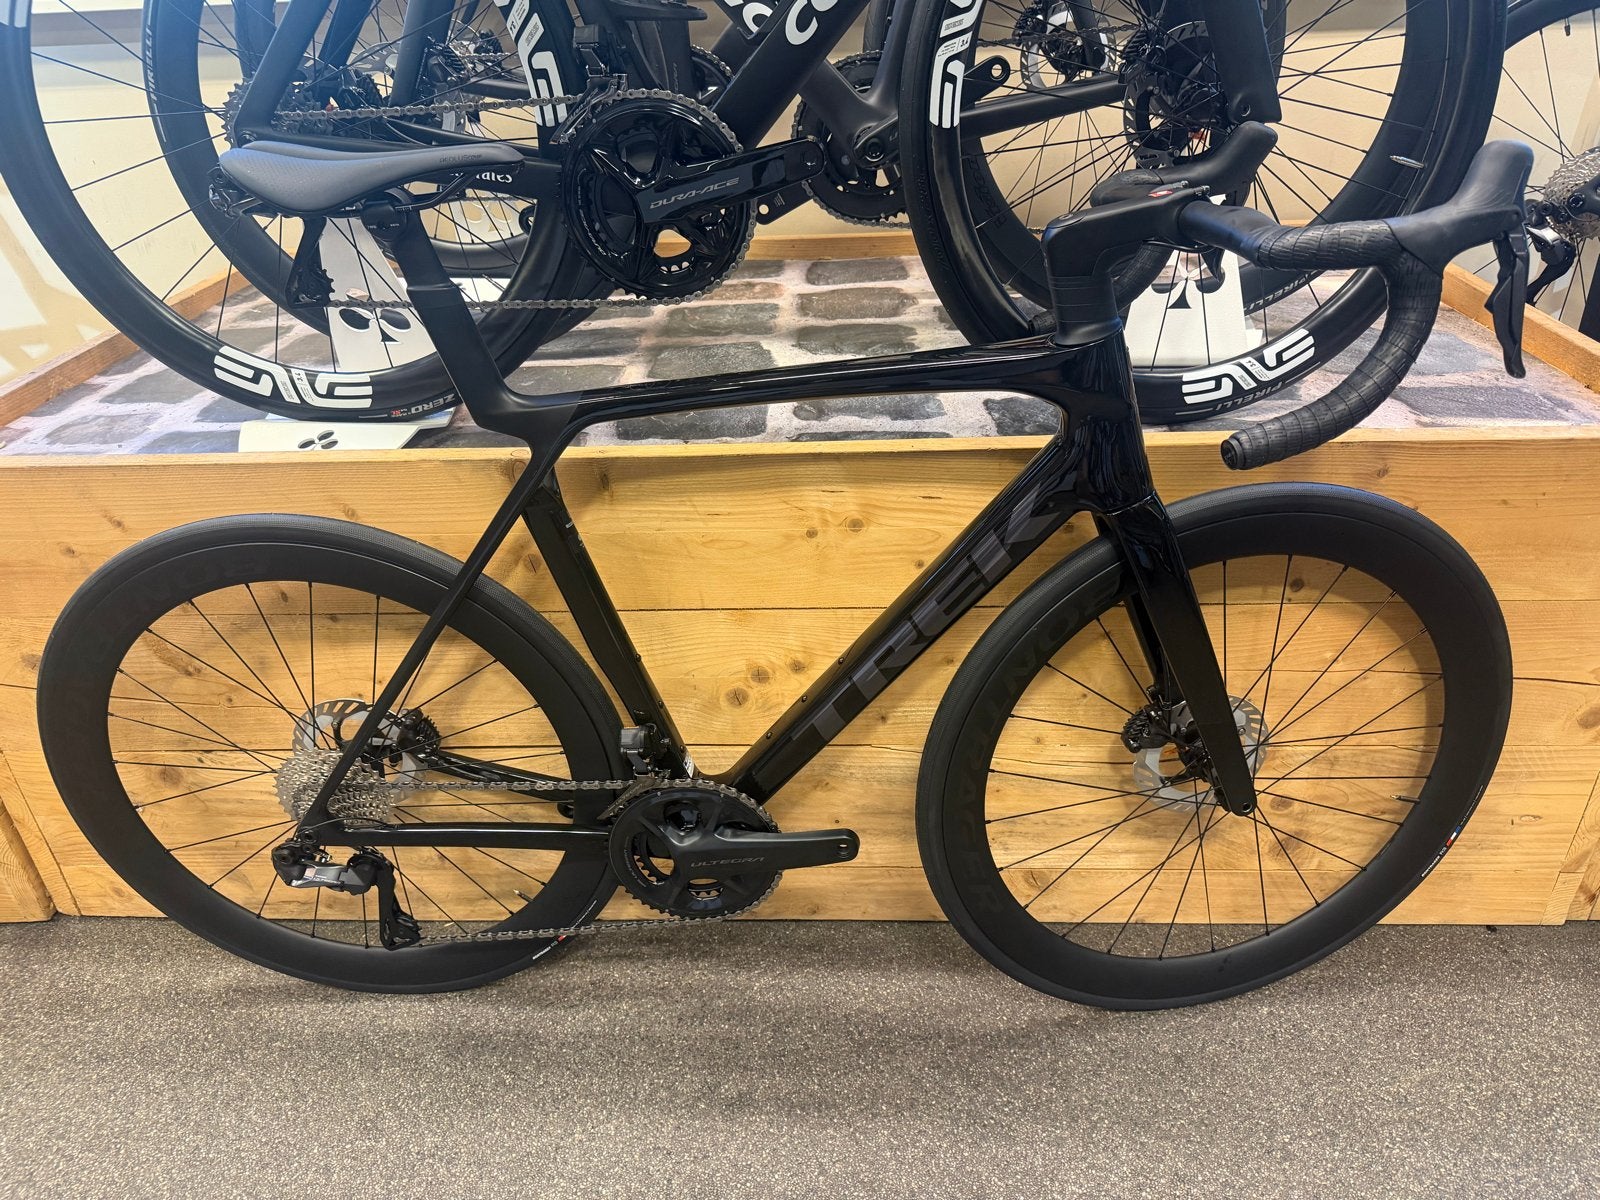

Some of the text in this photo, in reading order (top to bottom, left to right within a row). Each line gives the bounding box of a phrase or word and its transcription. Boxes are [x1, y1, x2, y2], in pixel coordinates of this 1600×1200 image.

[145, 27, 157, 101] PIRELLI
[649, 177, 740, 209] DURA-ACE
[411, 393, 456, 415] ZERO
[1216, 381, 1283, 411] PIRELLI
[791, 481, 1061, 742] TREK
[690, 856, 766, 868] ULTEGRA
